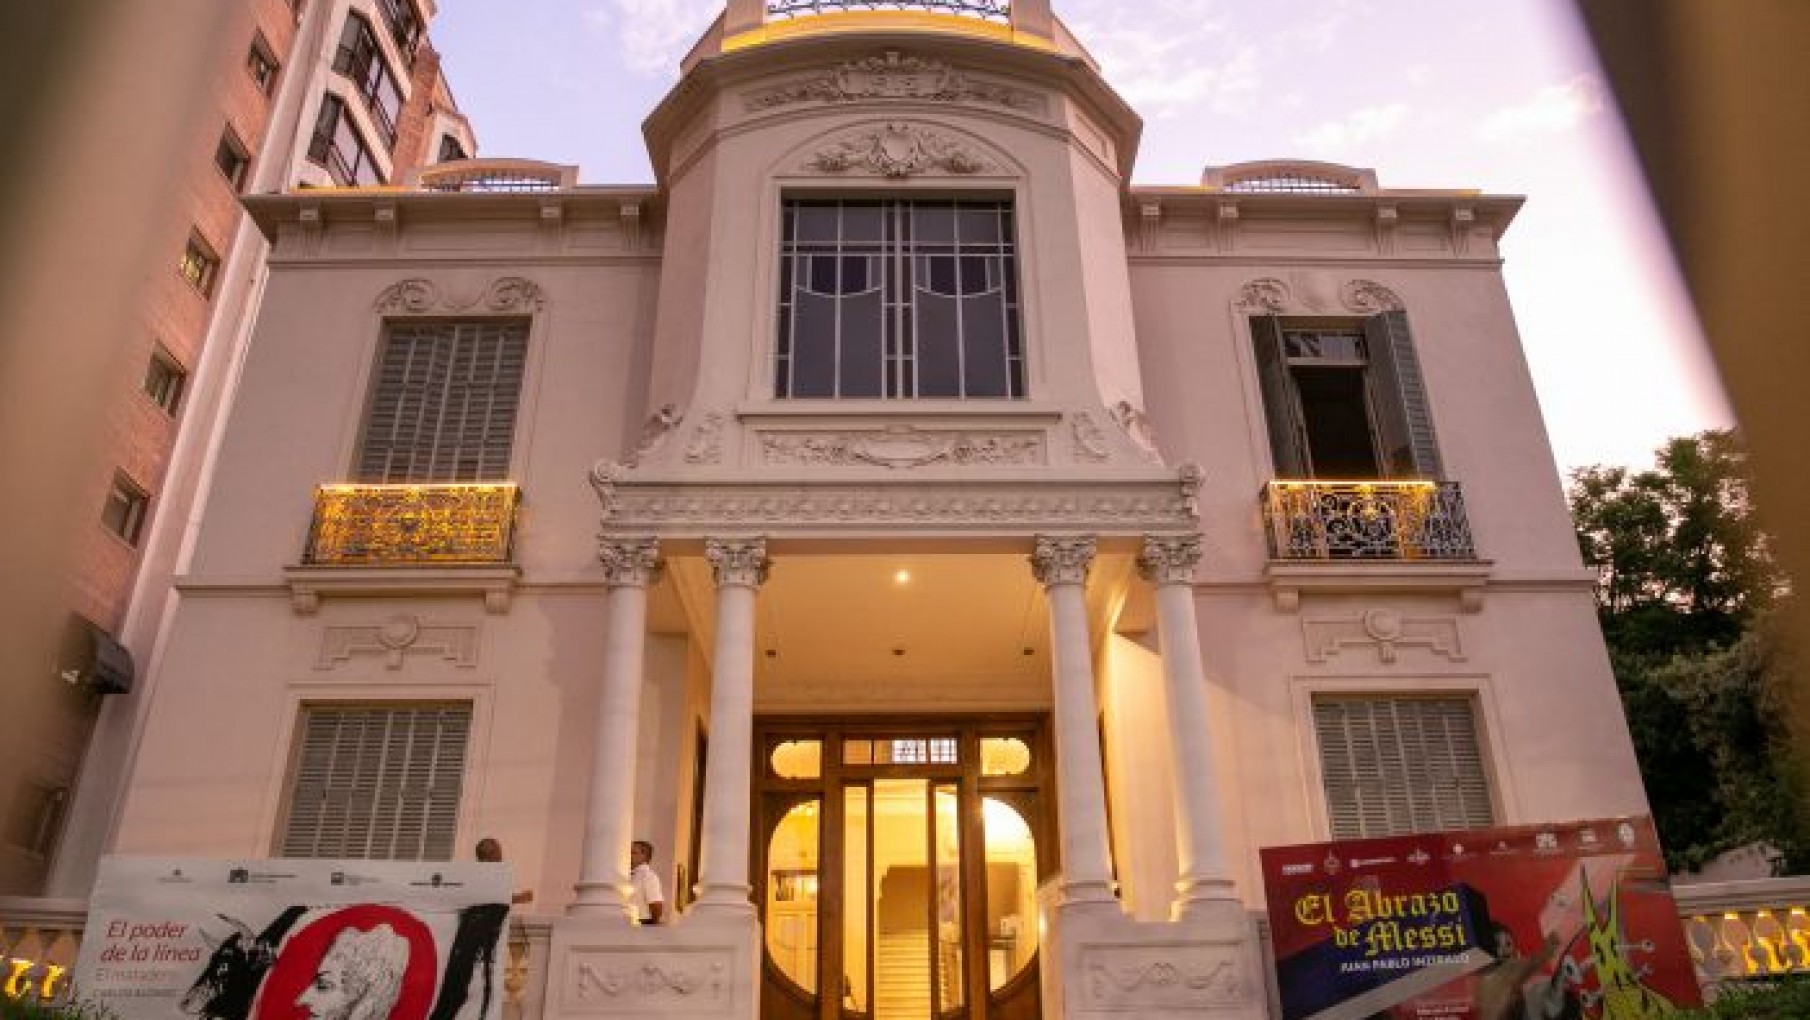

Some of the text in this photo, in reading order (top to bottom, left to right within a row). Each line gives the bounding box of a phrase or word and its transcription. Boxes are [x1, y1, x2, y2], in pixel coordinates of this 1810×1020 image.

[1295, 889, 1460, 925] El Abrazo
[107, 920, 189, 942] El poder
[1333, 919, 1466, 957] de Messi
[101, 943, 201, 962] de la línea
